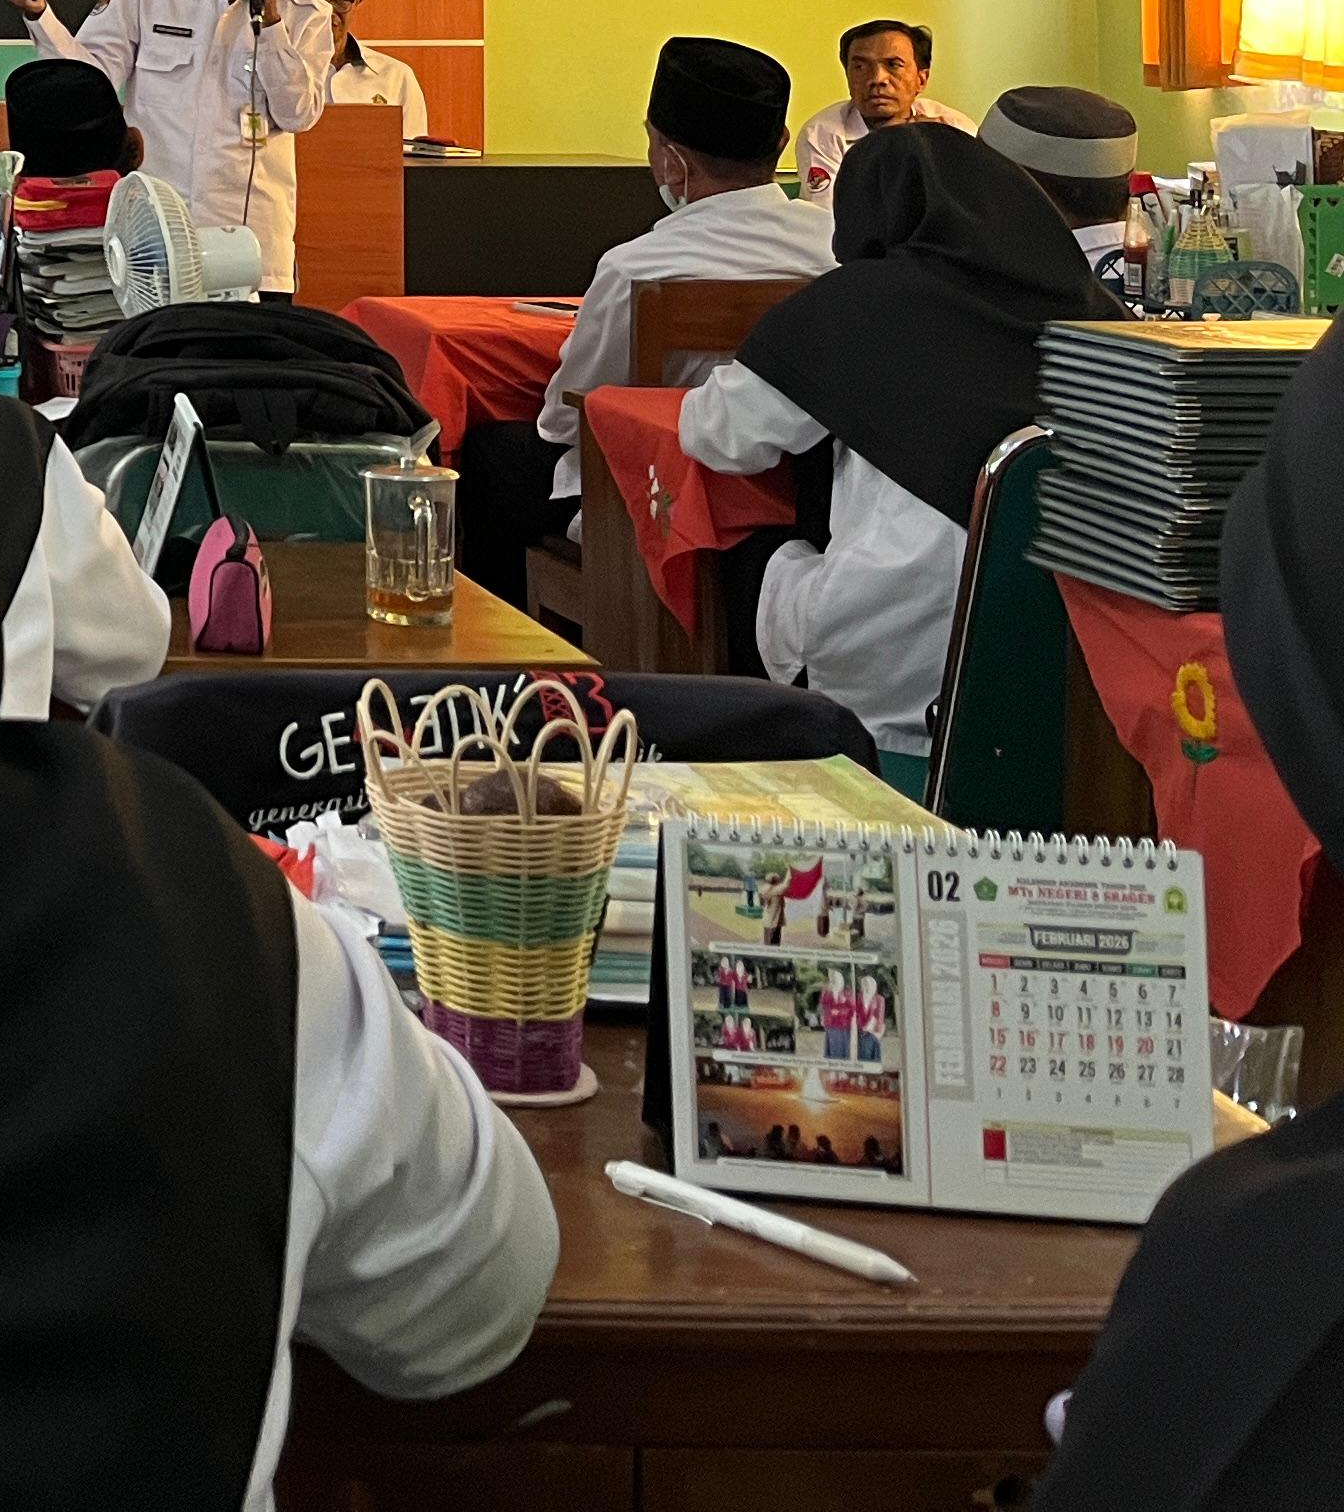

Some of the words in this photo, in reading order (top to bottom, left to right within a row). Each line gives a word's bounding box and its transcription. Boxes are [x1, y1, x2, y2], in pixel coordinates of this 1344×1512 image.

[928, 870, 961, 902] 02
[1038, 887, 1087, 901] NEGERI
[1104, 891, 1155, 904] SRAGEN
[1034, 931, 1095, 948] FEBRUARI
[1098, 934, 1129, 950] 2026
[992, 974, 997, 991] 1
[1021, 975, 1028, 992] 2
[1051, 978, 1059, 995] 3
[1080, 980, 1087, 996] 4
[1110, 982, 1118, 998] 5
[1138, 984, 1147, 1000] 6
[1168, 985, 1176, 1001] 7
[992, 1001, 1000, 1017] 8
[1021, 1003, 1030, 1019] 9
[1047, 1004, 1064, 1022] 10
[1077, 1006, 1092, 1024] 11
[1107, 1008, 1122, 1026] 12
[1137, 1009, 1153, 1027] 13
[1166, 1011, 1182, 1028] 14
[989, 1026, 1006, 1044] 15
[1019, 1030, 1036, 1047] 16
[1048, 1032, 1065, 1049] 17
[1079, 1033, 1095, 1051] 18
[1108, 1035, 1124, 1053] 19
[1137, 1037, 1154, 1054] 20
[1166, 1039, 1182, 1056] 21
[990, 1054, 1007, 1072] 22
[1020, 1057, 1036, 1074] 23
[1049, 1059, 1065, 1076] 24
[1079, 1061, 1095, 1078] 25
[1108, 1062, 1125, 1079] 26
[1137, 1064, 1154, 1081] 27
[1168, 1066, 1184, 1083] 28
